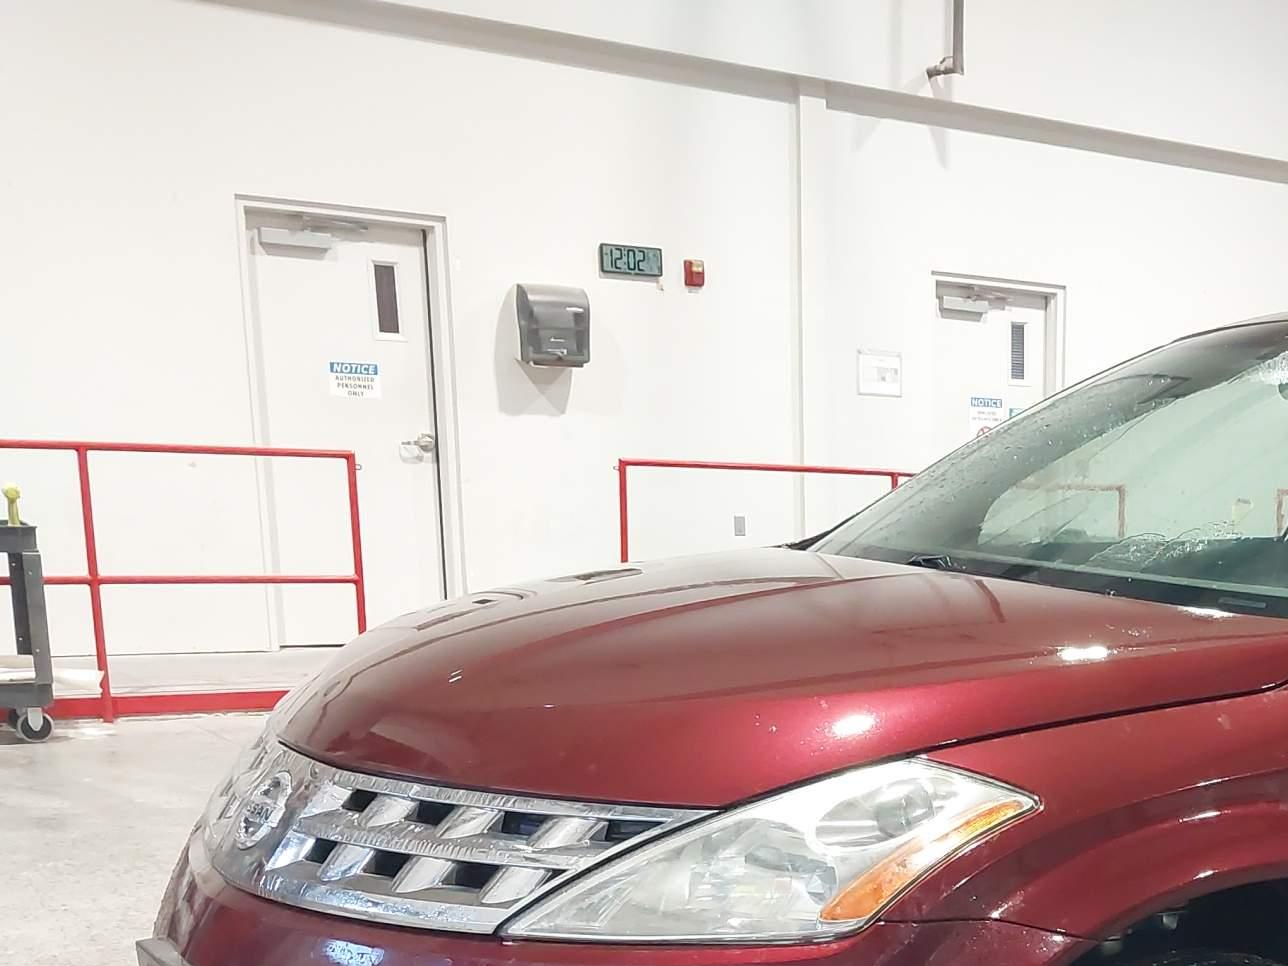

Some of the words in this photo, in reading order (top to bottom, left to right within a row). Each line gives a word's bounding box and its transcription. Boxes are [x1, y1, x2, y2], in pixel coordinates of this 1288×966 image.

[609, 247, 646, 272] 12:02
[332, 363, 377, 375] NOTICE
[335, 375, 375, 383] AUTHORIZED
[336, 382, 374, 390] PERSONNEL
[971, 398, 1001, 408] NOTICE
